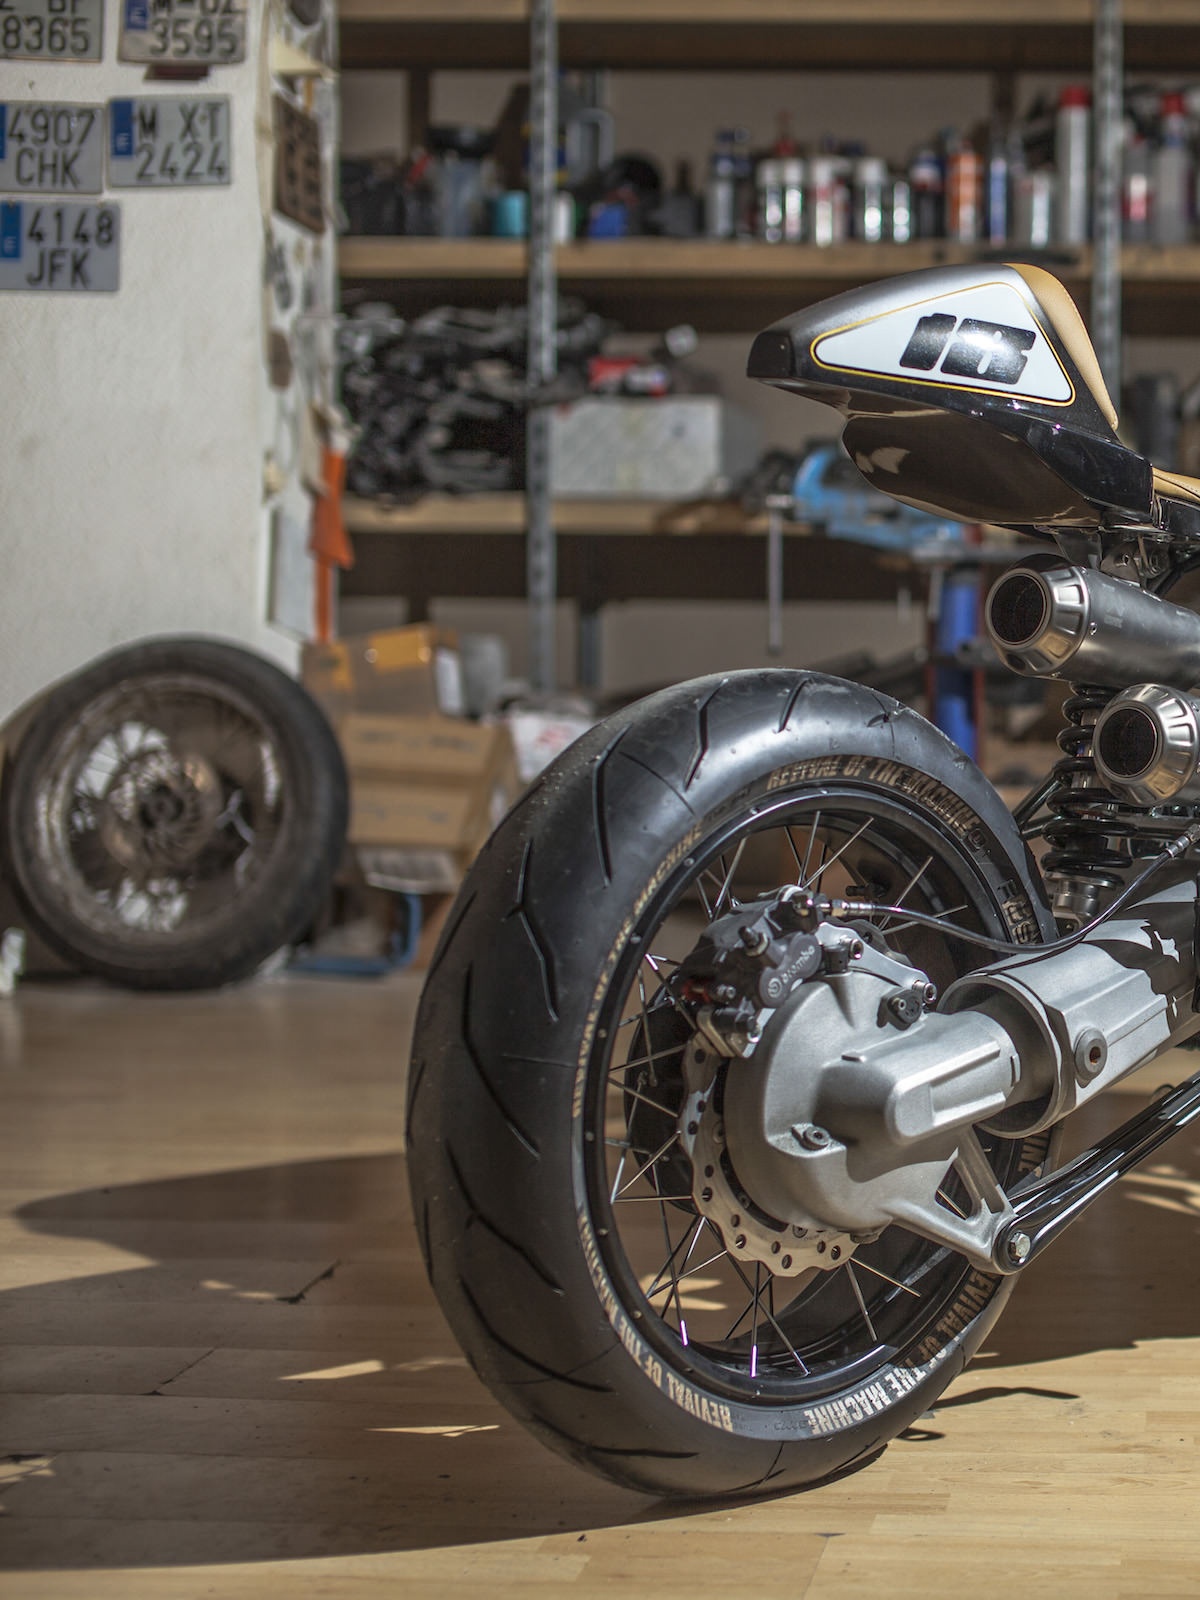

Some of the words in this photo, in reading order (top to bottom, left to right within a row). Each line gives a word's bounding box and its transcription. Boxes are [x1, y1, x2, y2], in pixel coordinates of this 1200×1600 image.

[3, 15, 90, 53] 8365
[151, 18, 237, 57] 3595
[8, 108, 96, 147] 4907
[16, 147, 80, 188] CHK
[136, 142, 226, 181] 2424
[27, 207, 114, 250] 4148
[25, 248, 91, 289] JFK
[781, 945, 816, 984] brembo
[619, 1325, 643, 1368] THE
[645, 1354, 663, 1388] OF
[884, 1358, 927, 1398] THE
[667, 1372, 733, 1433] REVIVAL
[804, 1381, 892, 1436] MACHINE
